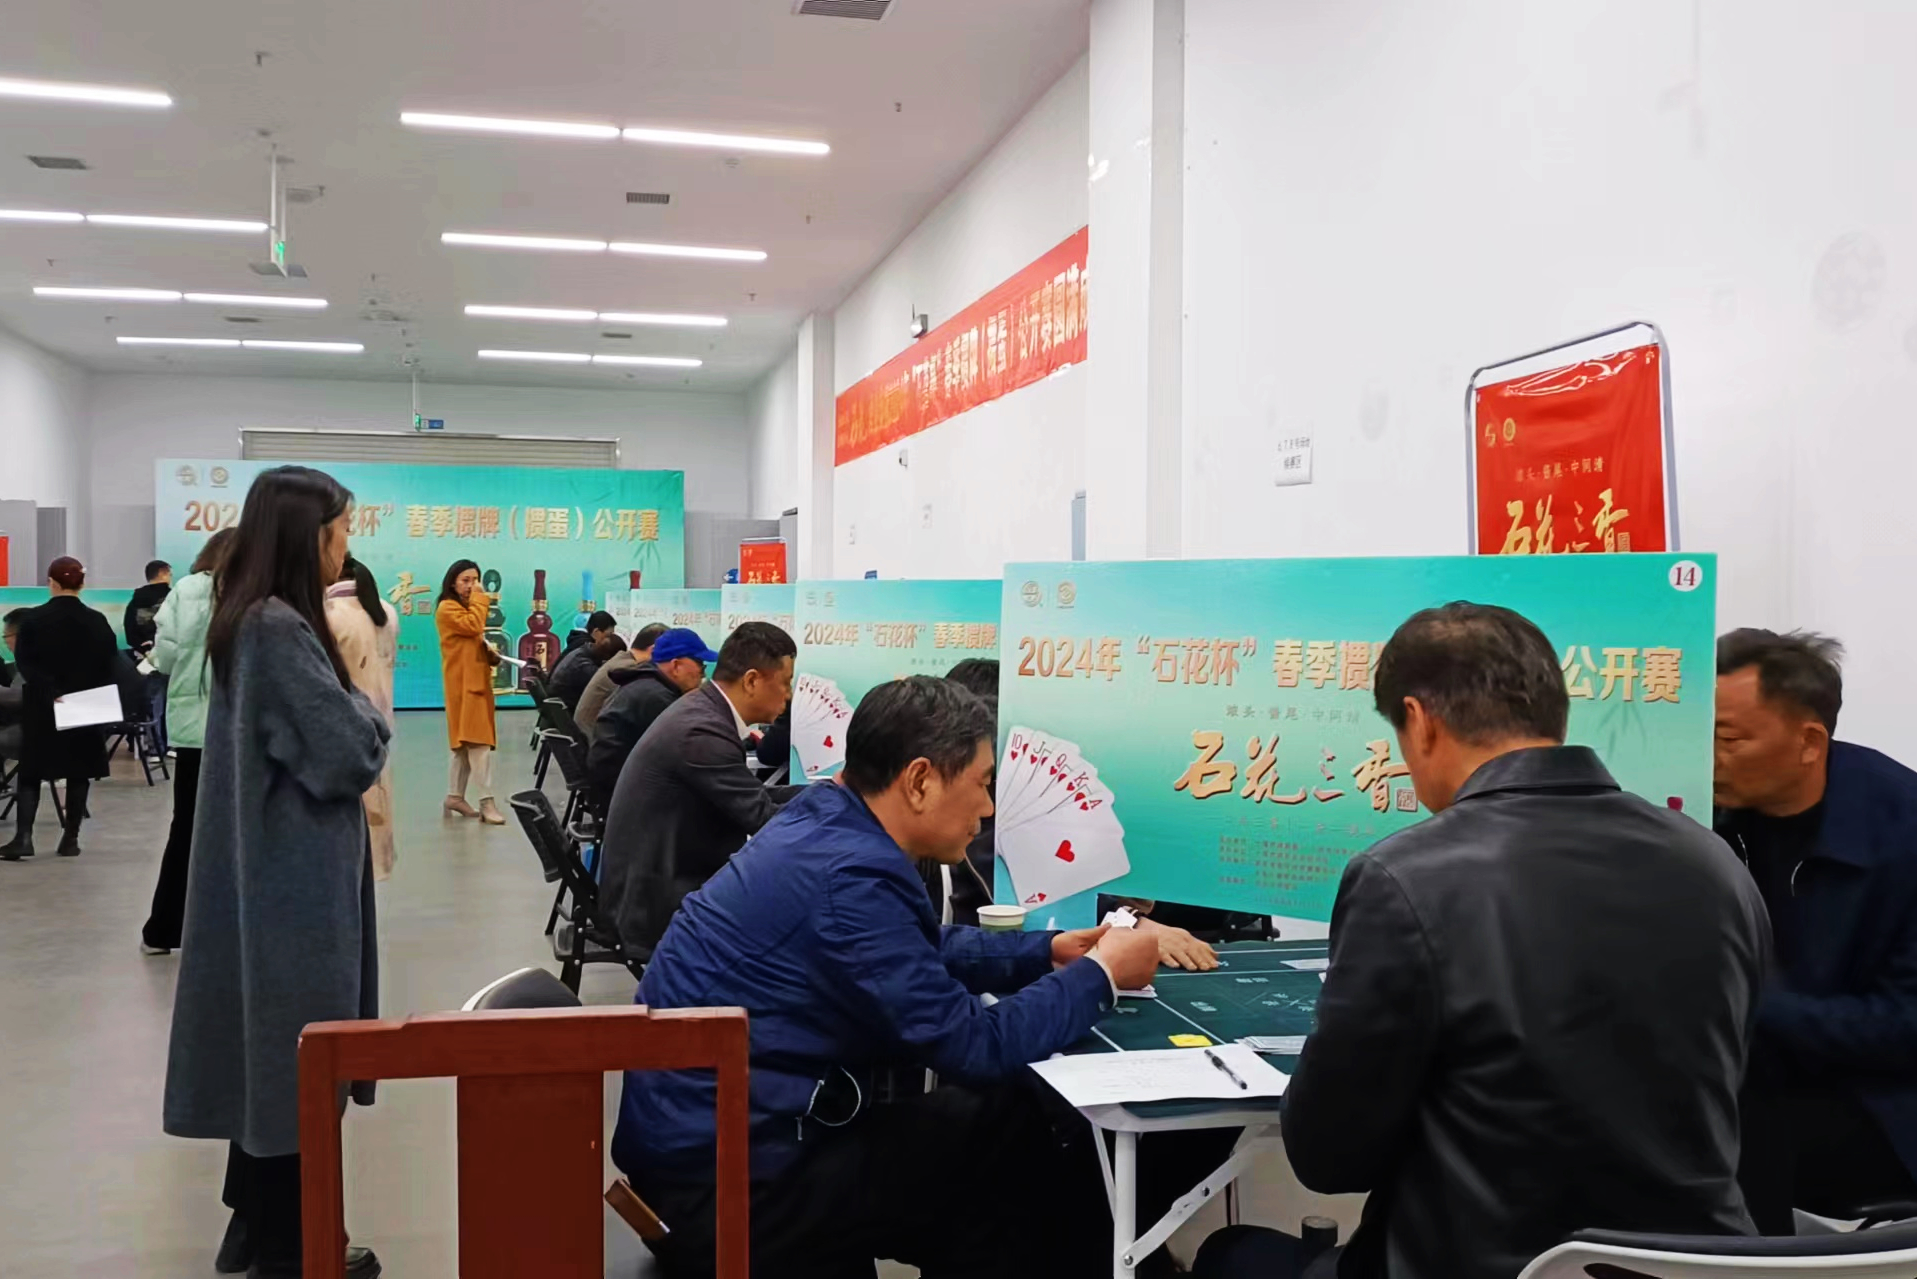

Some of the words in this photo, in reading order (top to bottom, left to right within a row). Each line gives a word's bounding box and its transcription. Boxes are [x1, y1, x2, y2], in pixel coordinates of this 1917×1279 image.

[1674, 567, 1697, 586] 14
[1561, 646, 1682, 704] 公开赛
[1011, 733, 1023, 750] 10
[1032, 741, 1046, 754] J
[1055, 753, 1067, 768] Q
[1073, 771, 1089, 787] K
[1090, 798, 1103, 810] A
